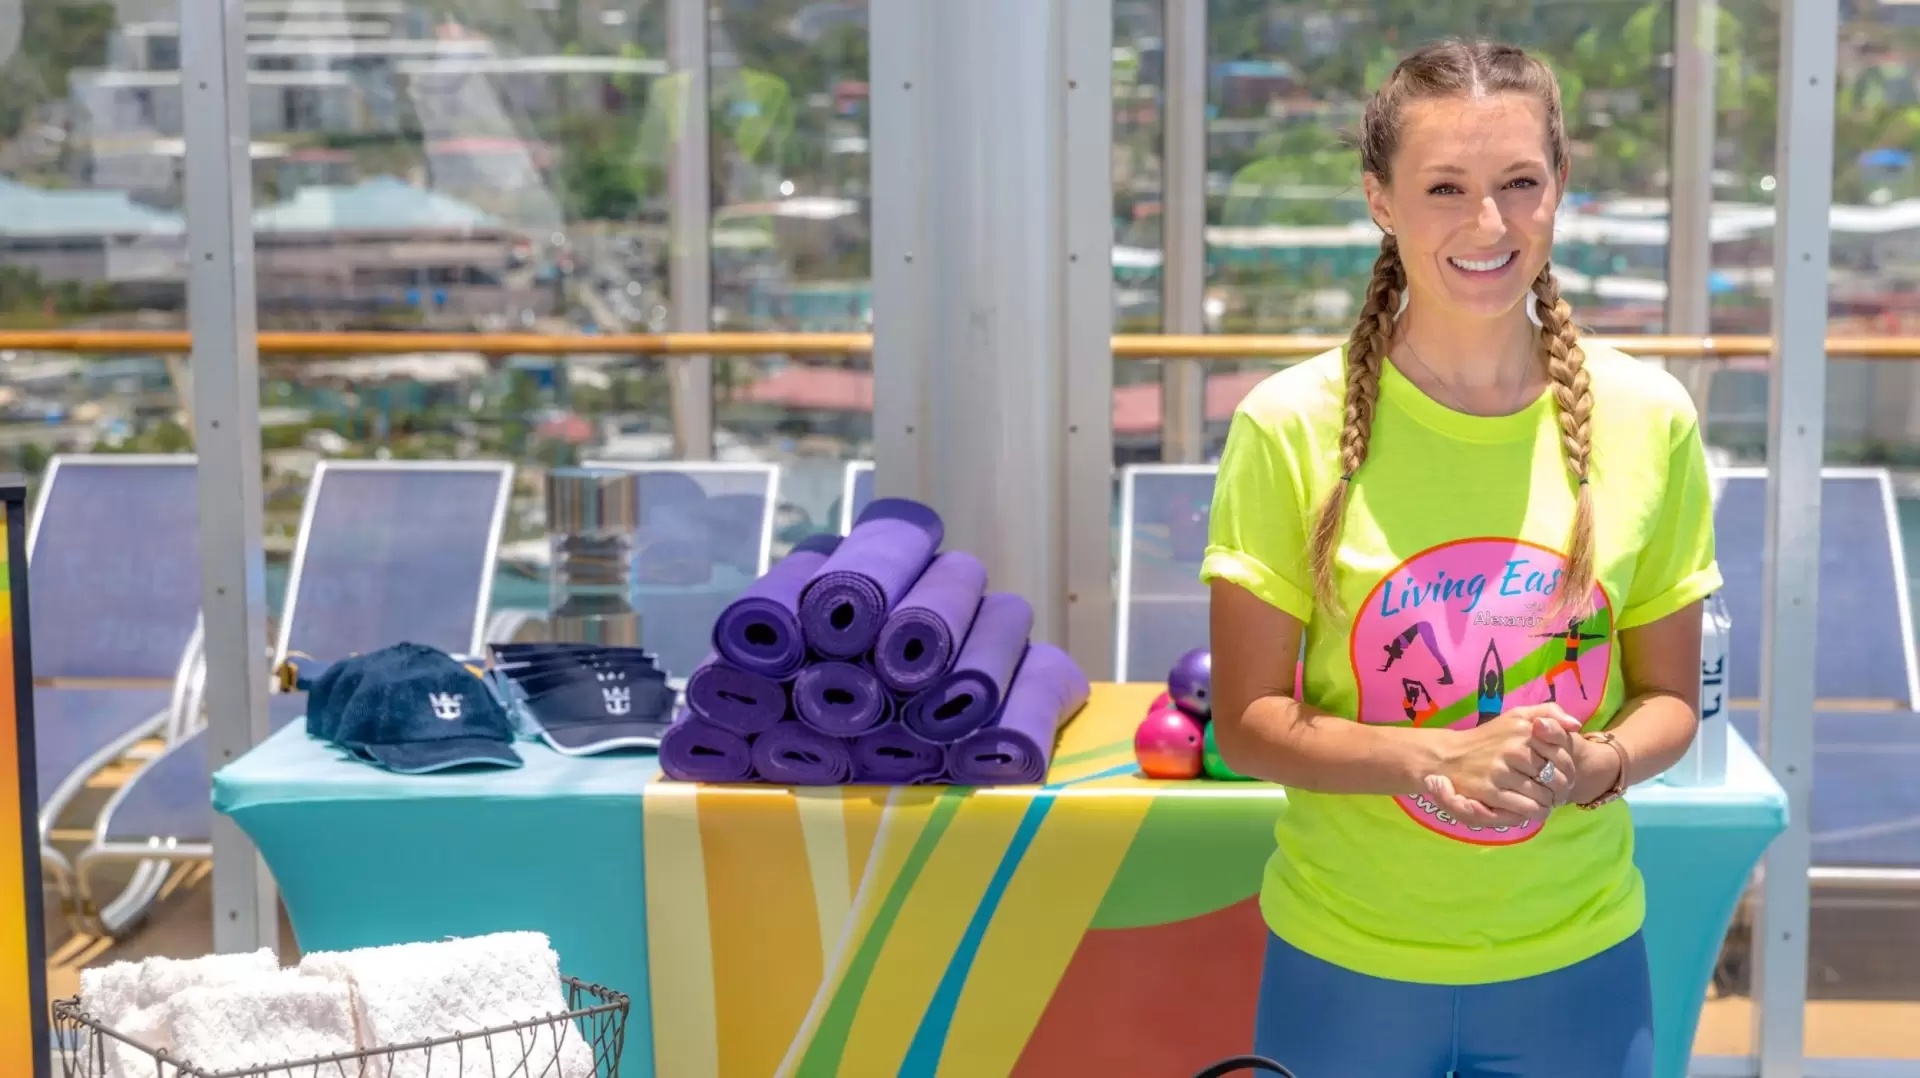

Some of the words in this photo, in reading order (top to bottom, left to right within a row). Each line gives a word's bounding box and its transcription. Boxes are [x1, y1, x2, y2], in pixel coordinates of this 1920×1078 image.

[1380, 571, 1487, 617] Living
[1499, 559, 1563, 596] Eas
[1473, 610, 1545, 628] Alexandr
